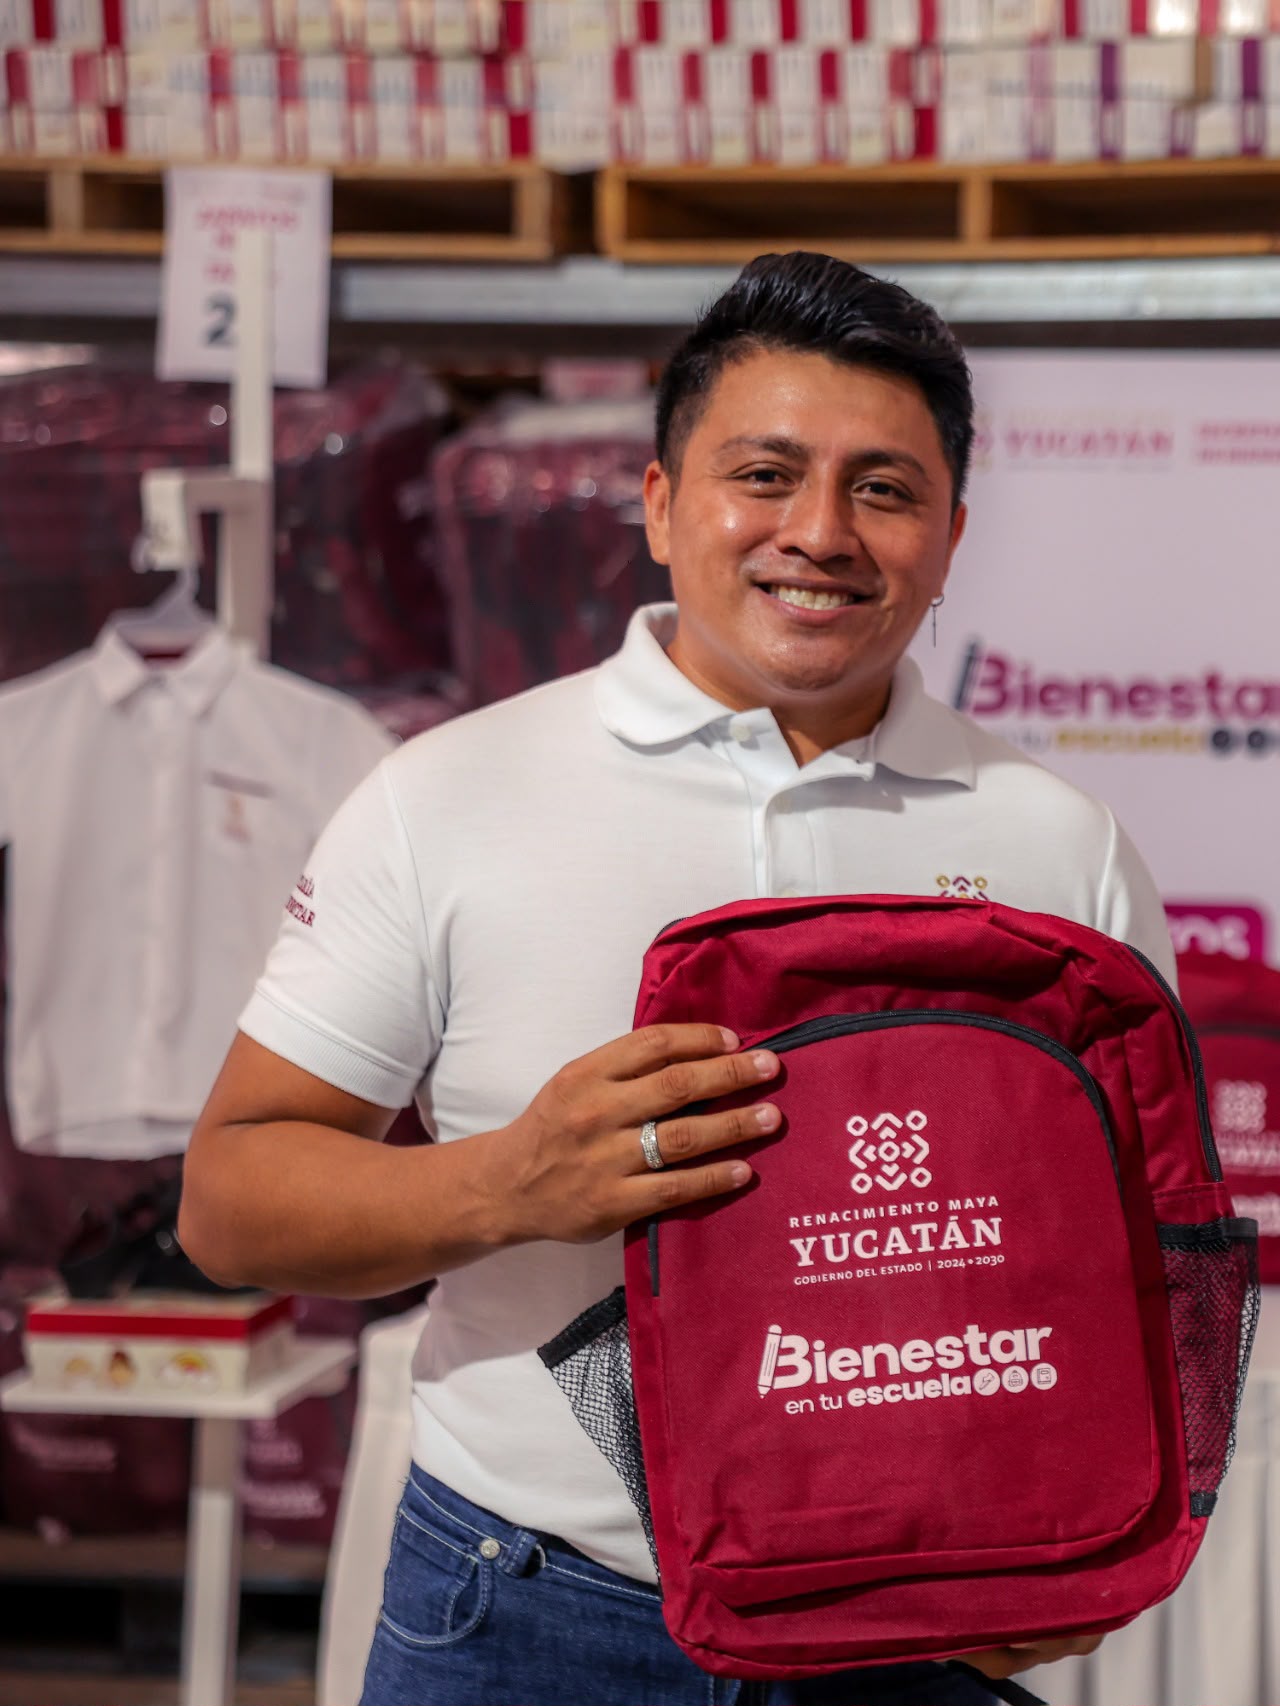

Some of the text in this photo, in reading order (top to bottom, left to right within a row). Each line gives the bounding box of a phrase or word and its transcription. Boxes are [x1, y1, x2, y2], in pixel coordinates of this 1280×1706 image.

[205, 294, 240, 348] 2
[789, 1196, 999, 1229] RENACIMIENTO MAYA
[789, 1215, 1002, 1267] YUCATÁN
[794, 1270, 853, 1286] GOBIERNO
[856, 1269, 878, 1279] DEL
[880, 1262, 923, 1276] ESTADO
[757, 1324, 1053, 1399] Bienestar
[785, 1373, 973, 1415] en tu escuela
